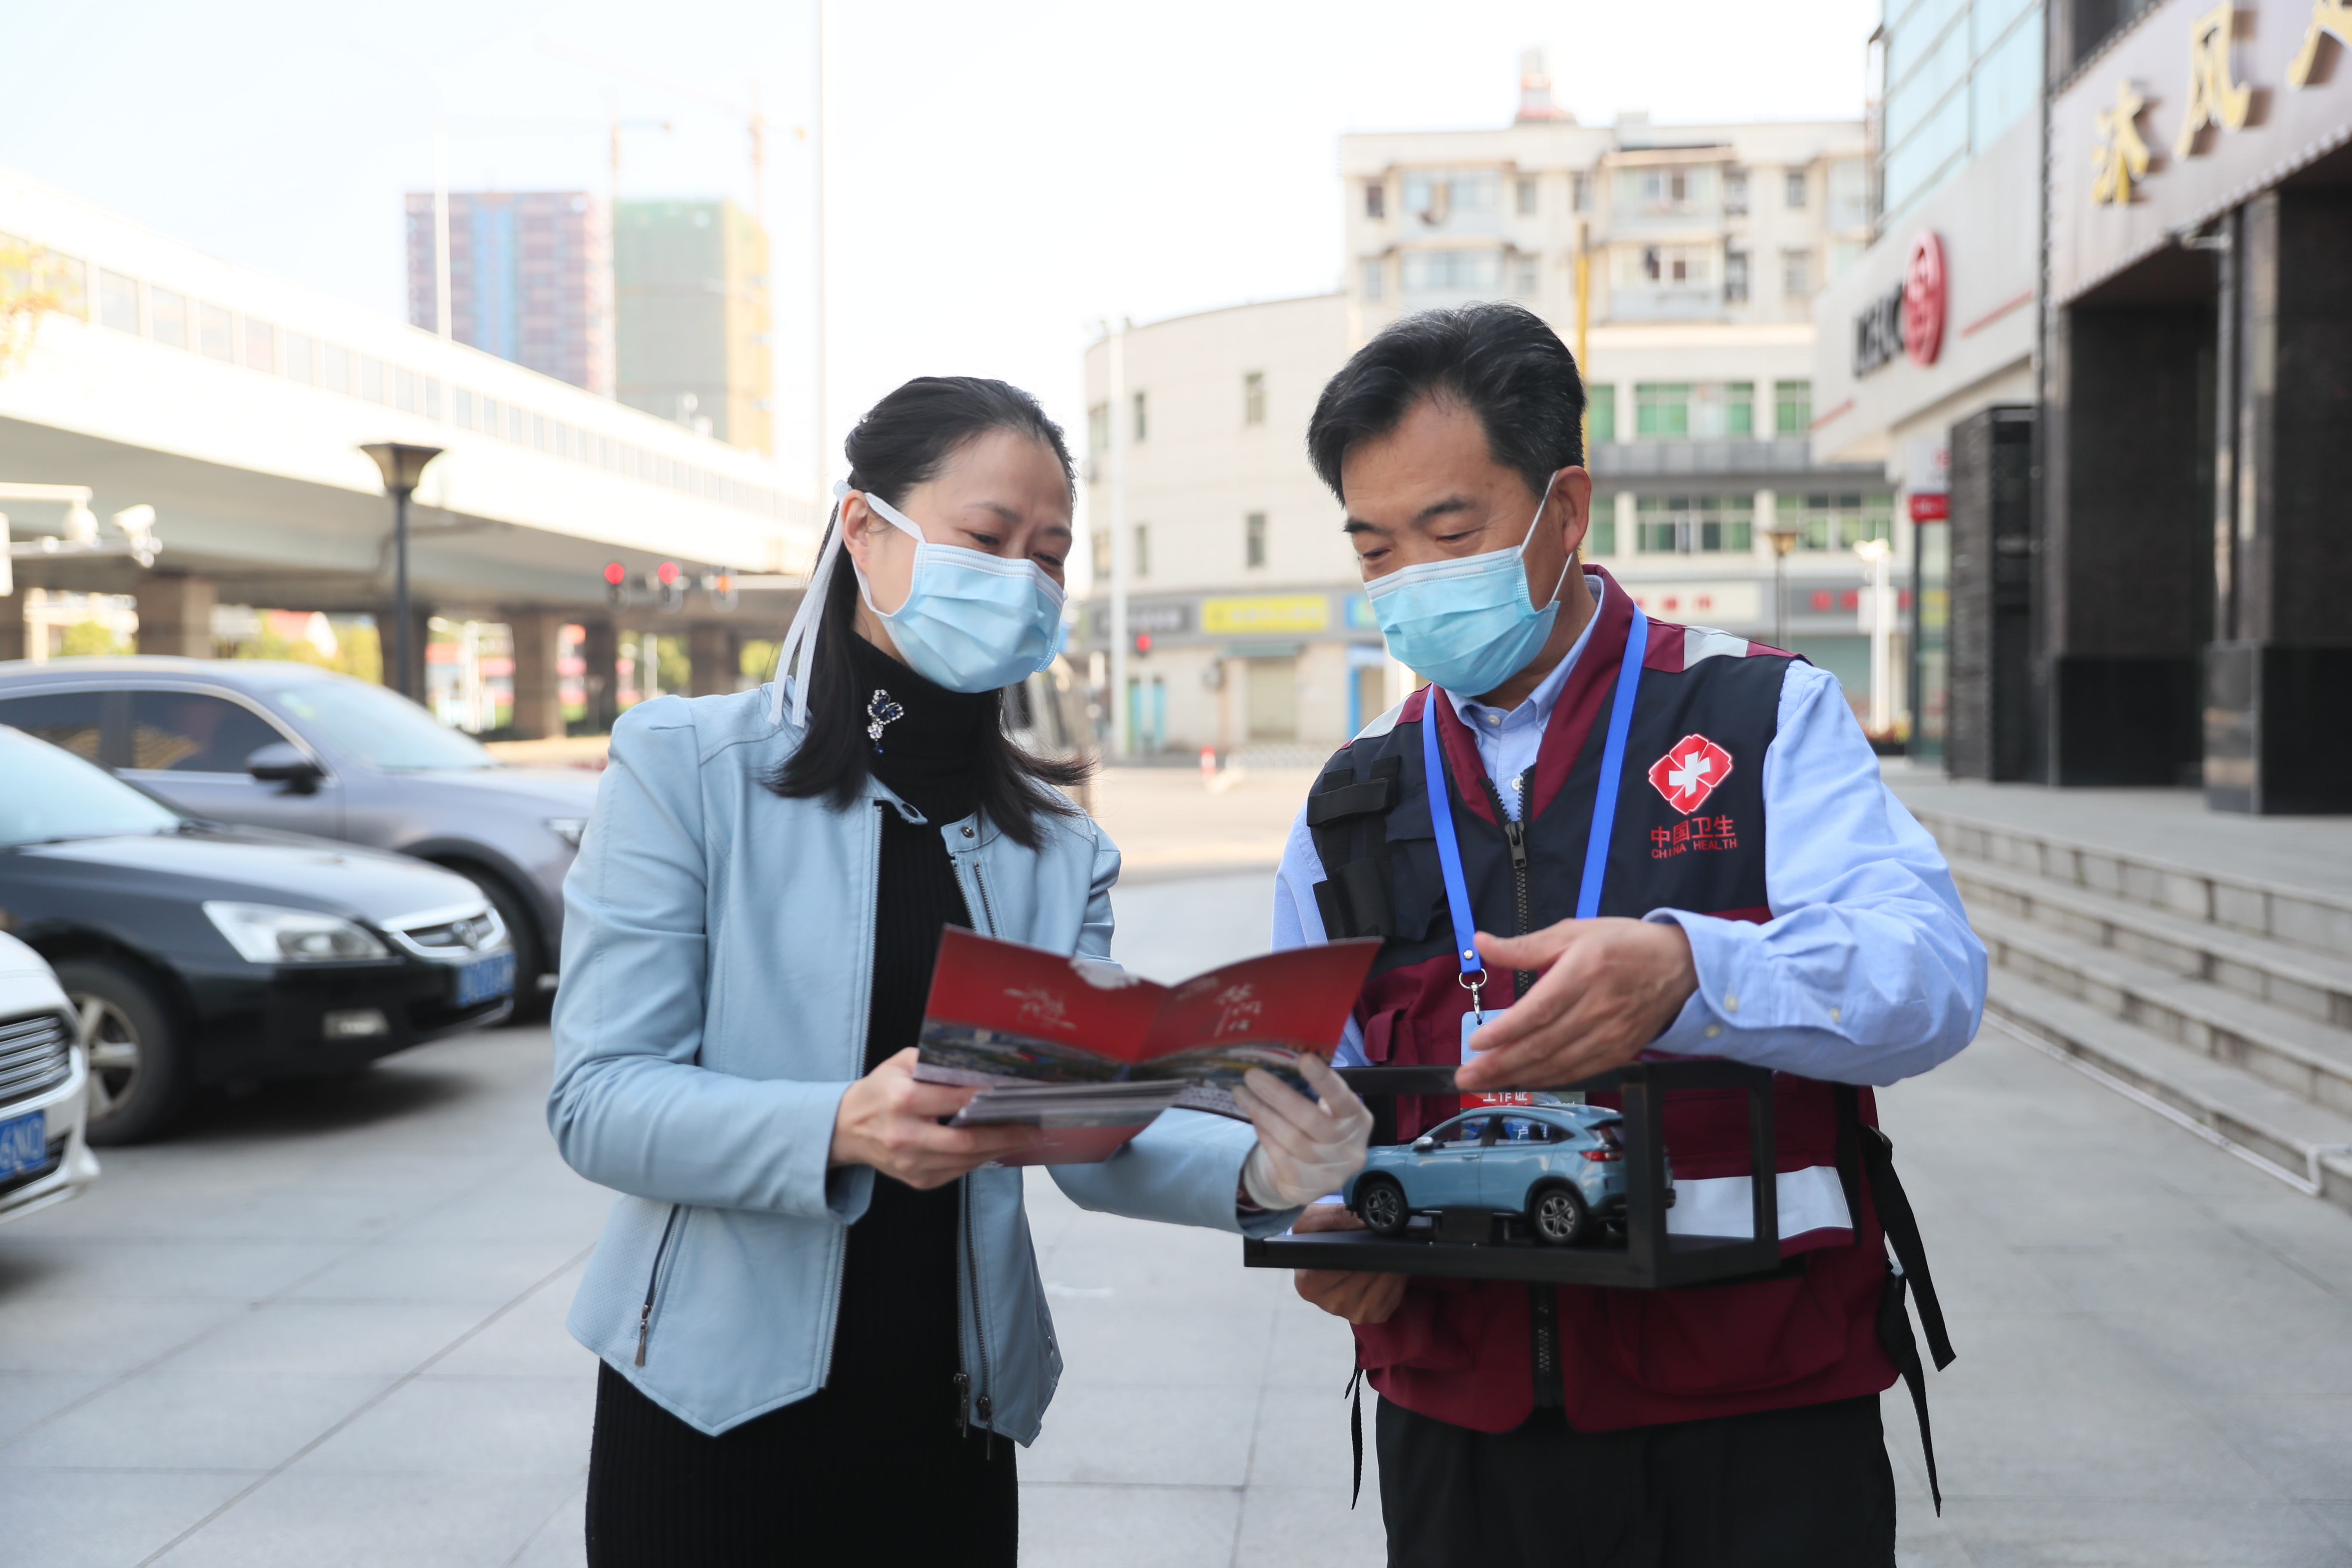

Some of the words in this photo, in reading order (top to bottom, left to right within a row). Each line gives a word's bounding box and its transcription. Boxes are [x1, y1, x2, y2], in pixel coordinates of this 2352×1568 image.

[1651, 815, 1735, 848] 中国卫生
[1651, 843, 1687, 858] CHINA
[1693, 838, 1737, 850] HEALTH
